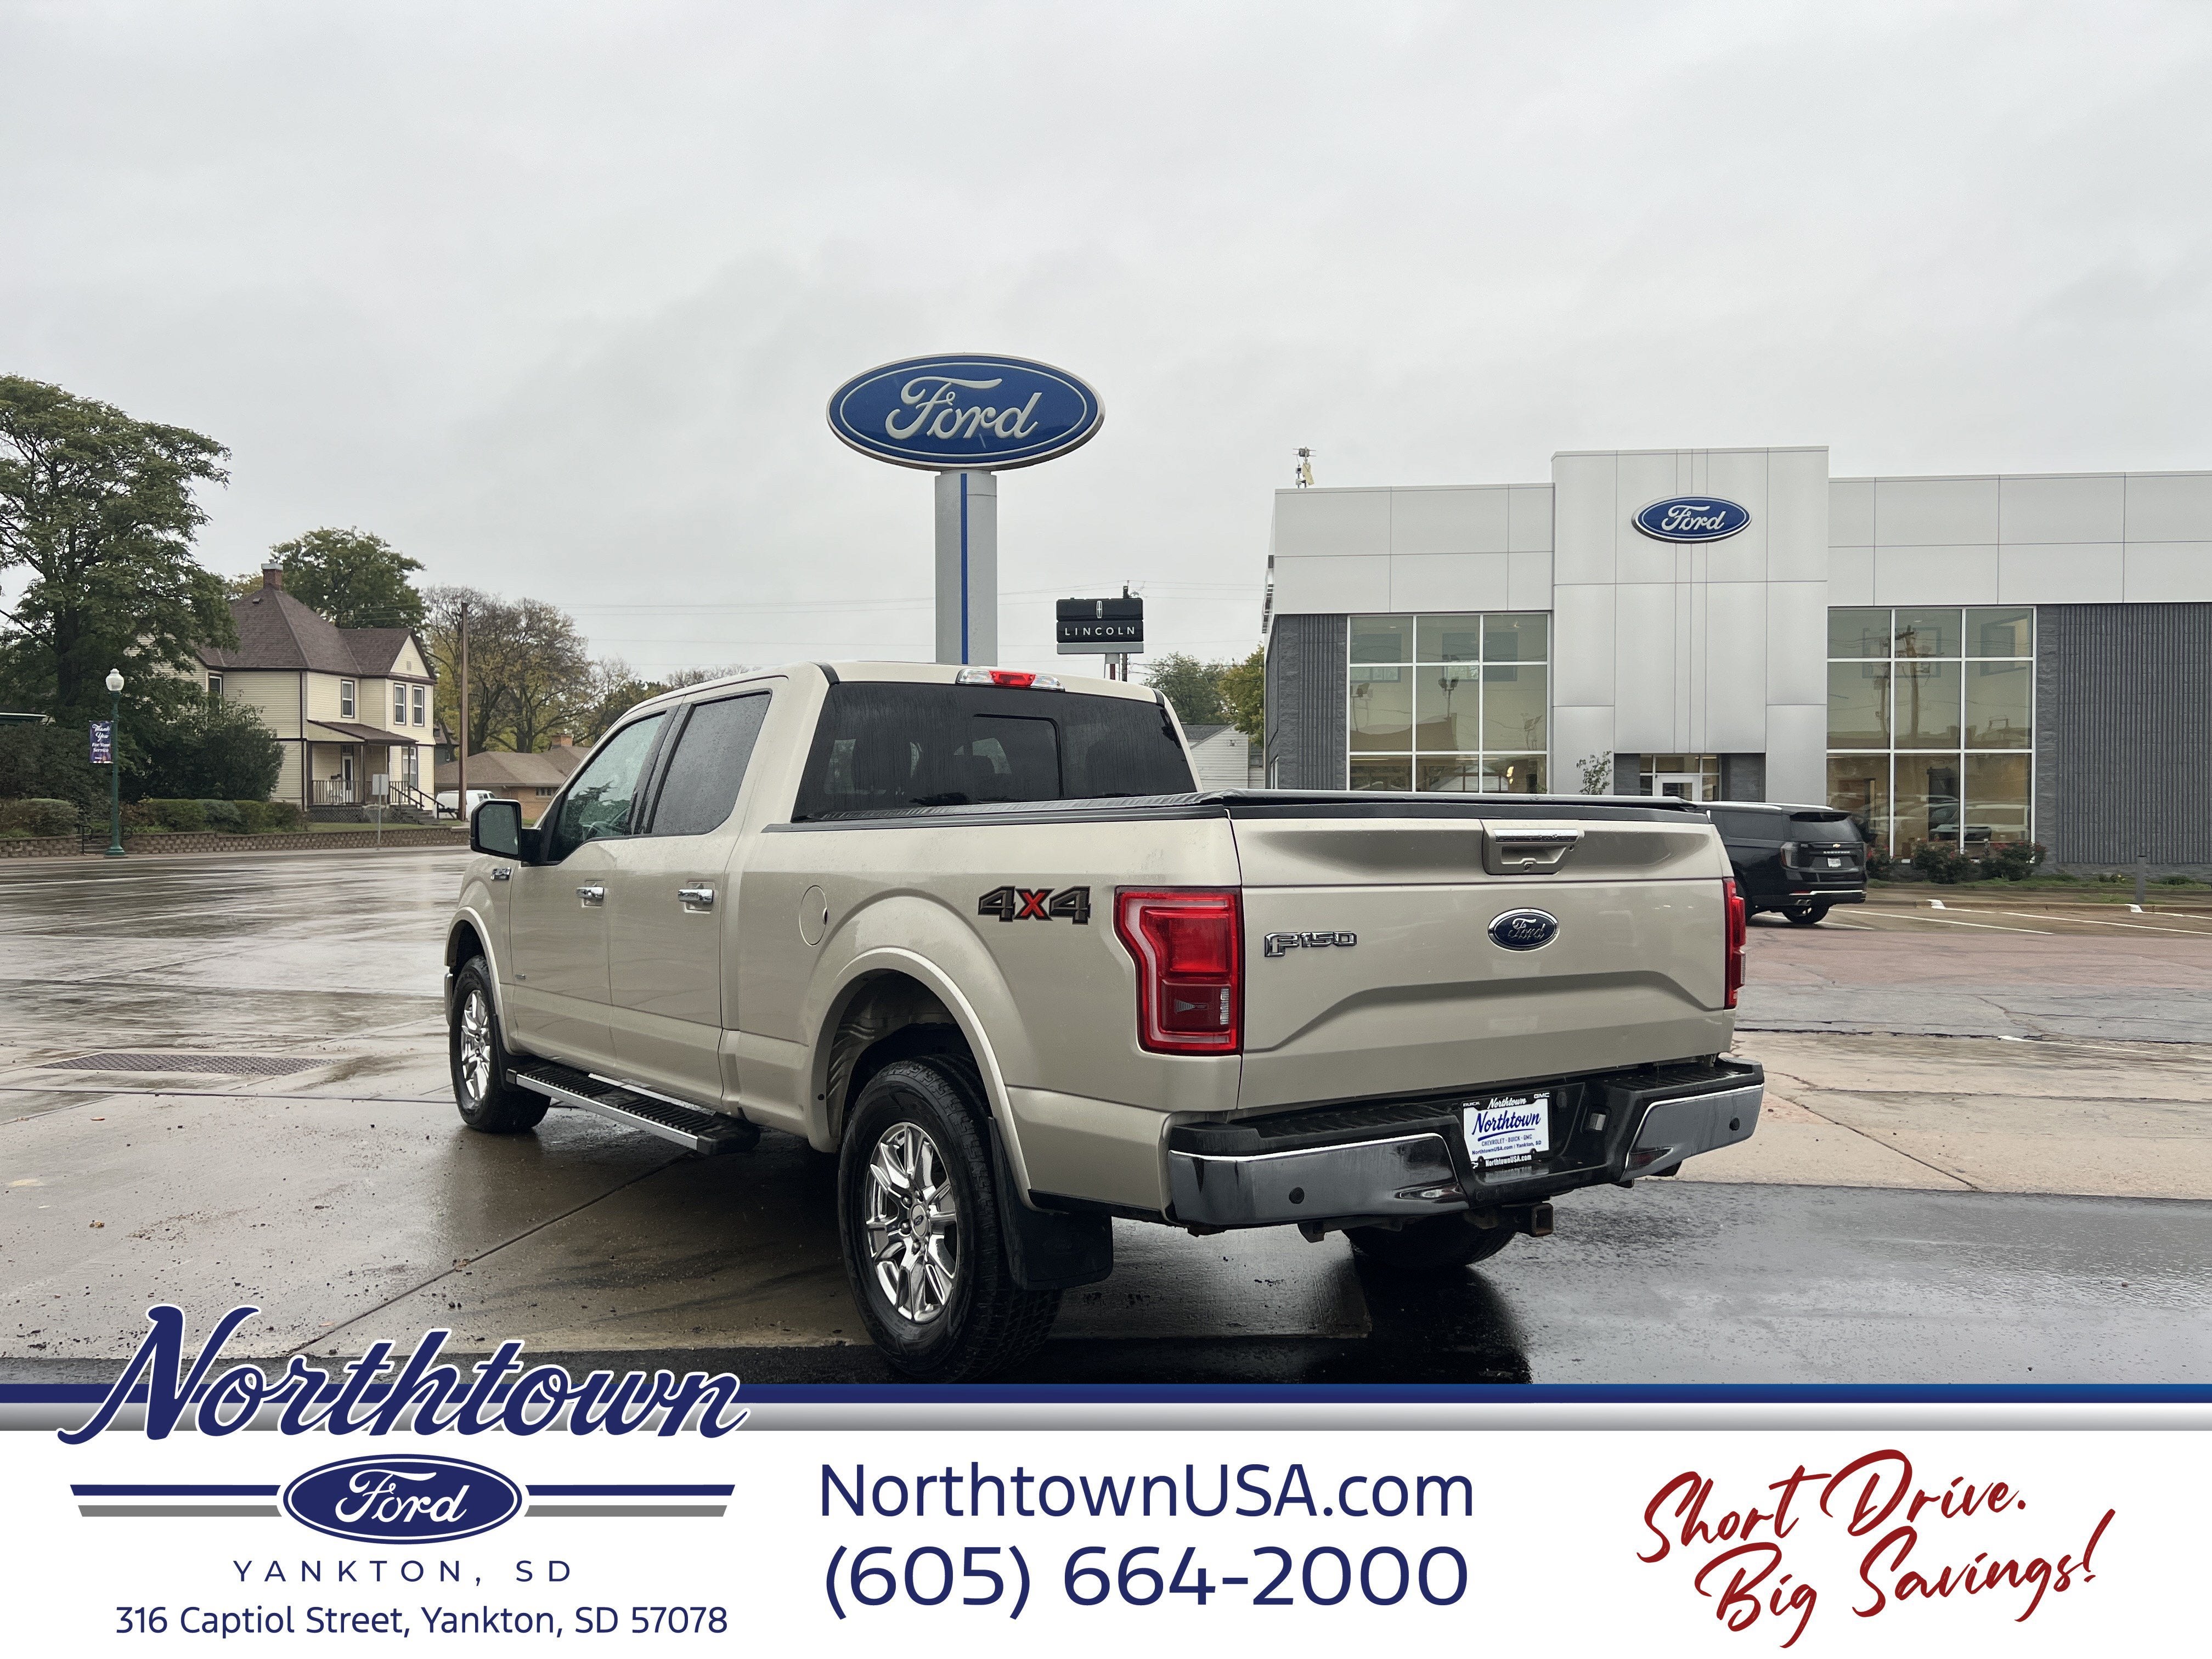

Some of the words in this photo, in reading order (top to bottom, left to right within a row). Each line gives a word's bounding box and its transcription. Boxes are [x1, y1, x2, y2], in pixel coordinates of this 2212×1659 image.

[885, 376, 1042, 439] Ford
[1661, 504, 1726, 531] Ford
[1065, 626, 1135, 636] LINCOLN
[1508, 917, 1546, 940] Ford
[1487, 1097, 1527, 1110] Northtown
[1471, 1110, 1541, 1135] Northtown
[1481, 1138, 1505, 1147] CHEVROLET
[1472, 1145, 1513, 1155] NorthtownUSA.com
[1485, 1154, 1532, 1167] NorthtownUSA.com
